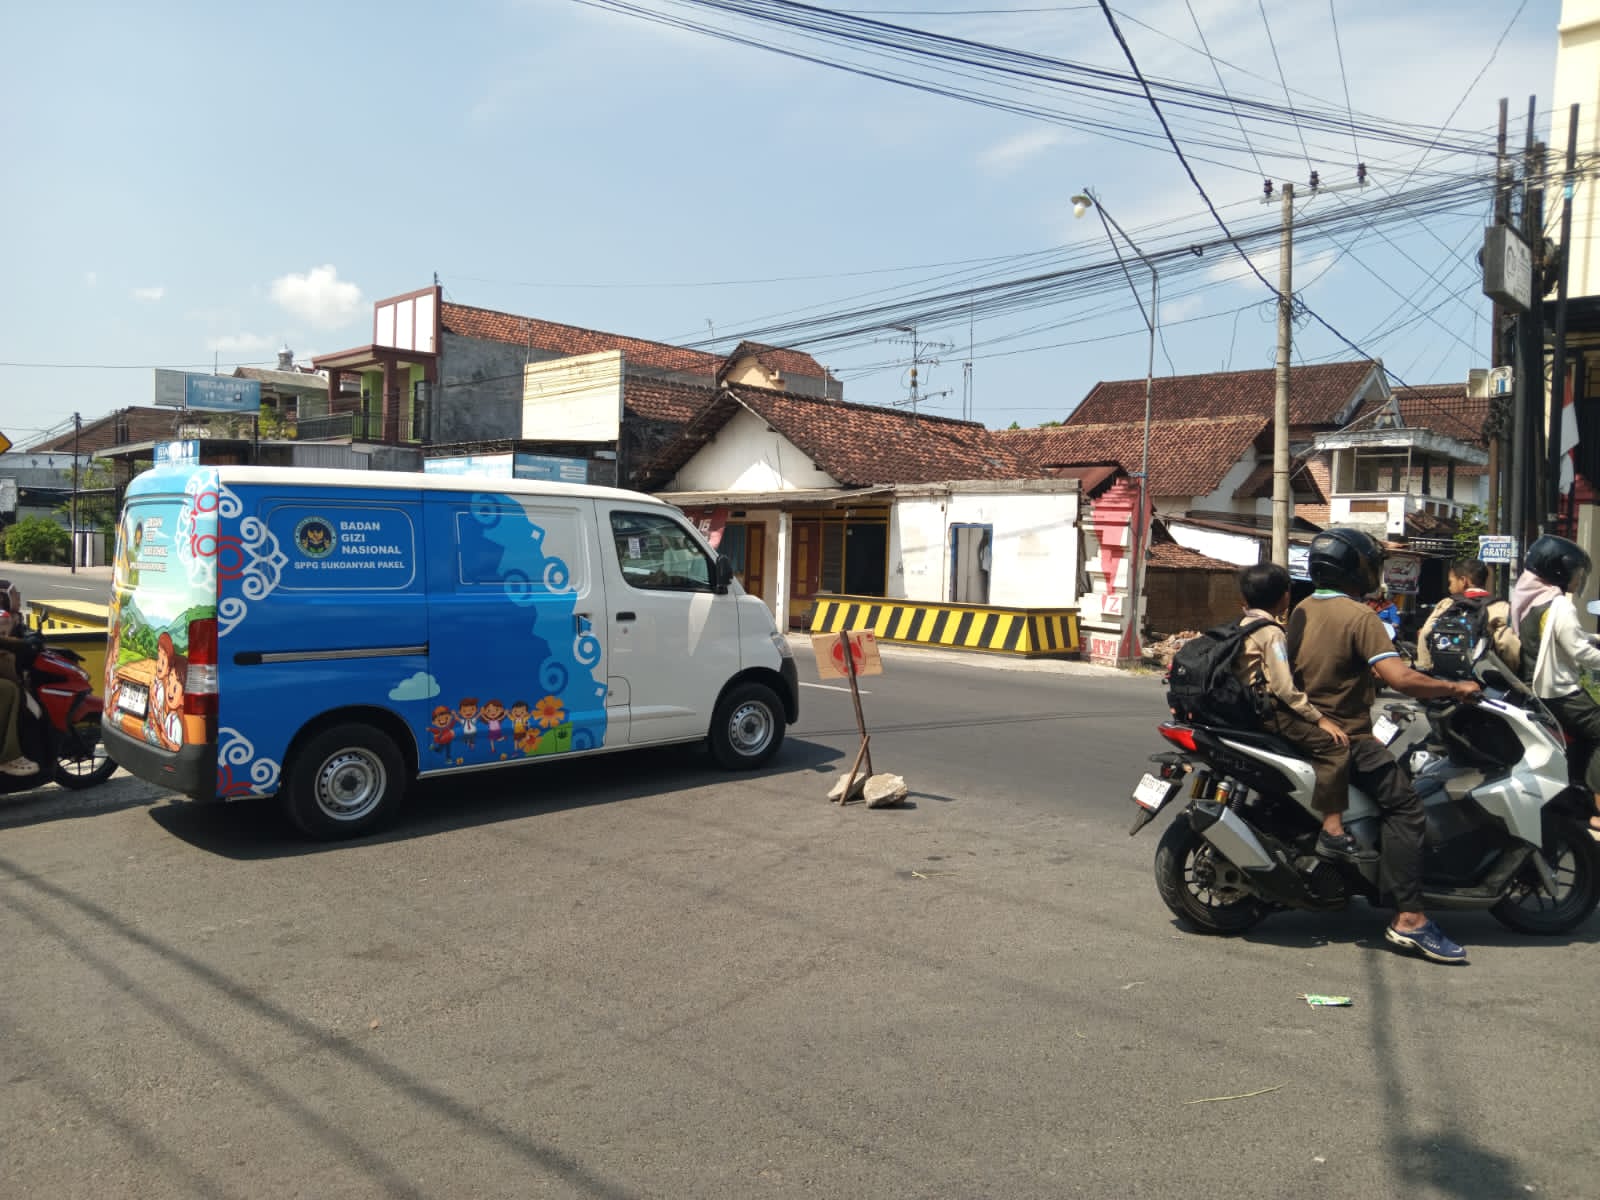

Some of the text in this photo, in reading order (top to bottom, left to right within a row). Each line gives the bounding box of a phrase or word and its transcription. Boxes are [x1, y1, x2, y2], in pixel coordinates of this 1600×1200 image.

[340, 521, 381, 531] BADAN
[341, 533, 365, 542] GIZI
[341, 545, 403, 554] NASIONAL
[294, 561, 405, 569] SPPG SUKOANYAR PAKEL
